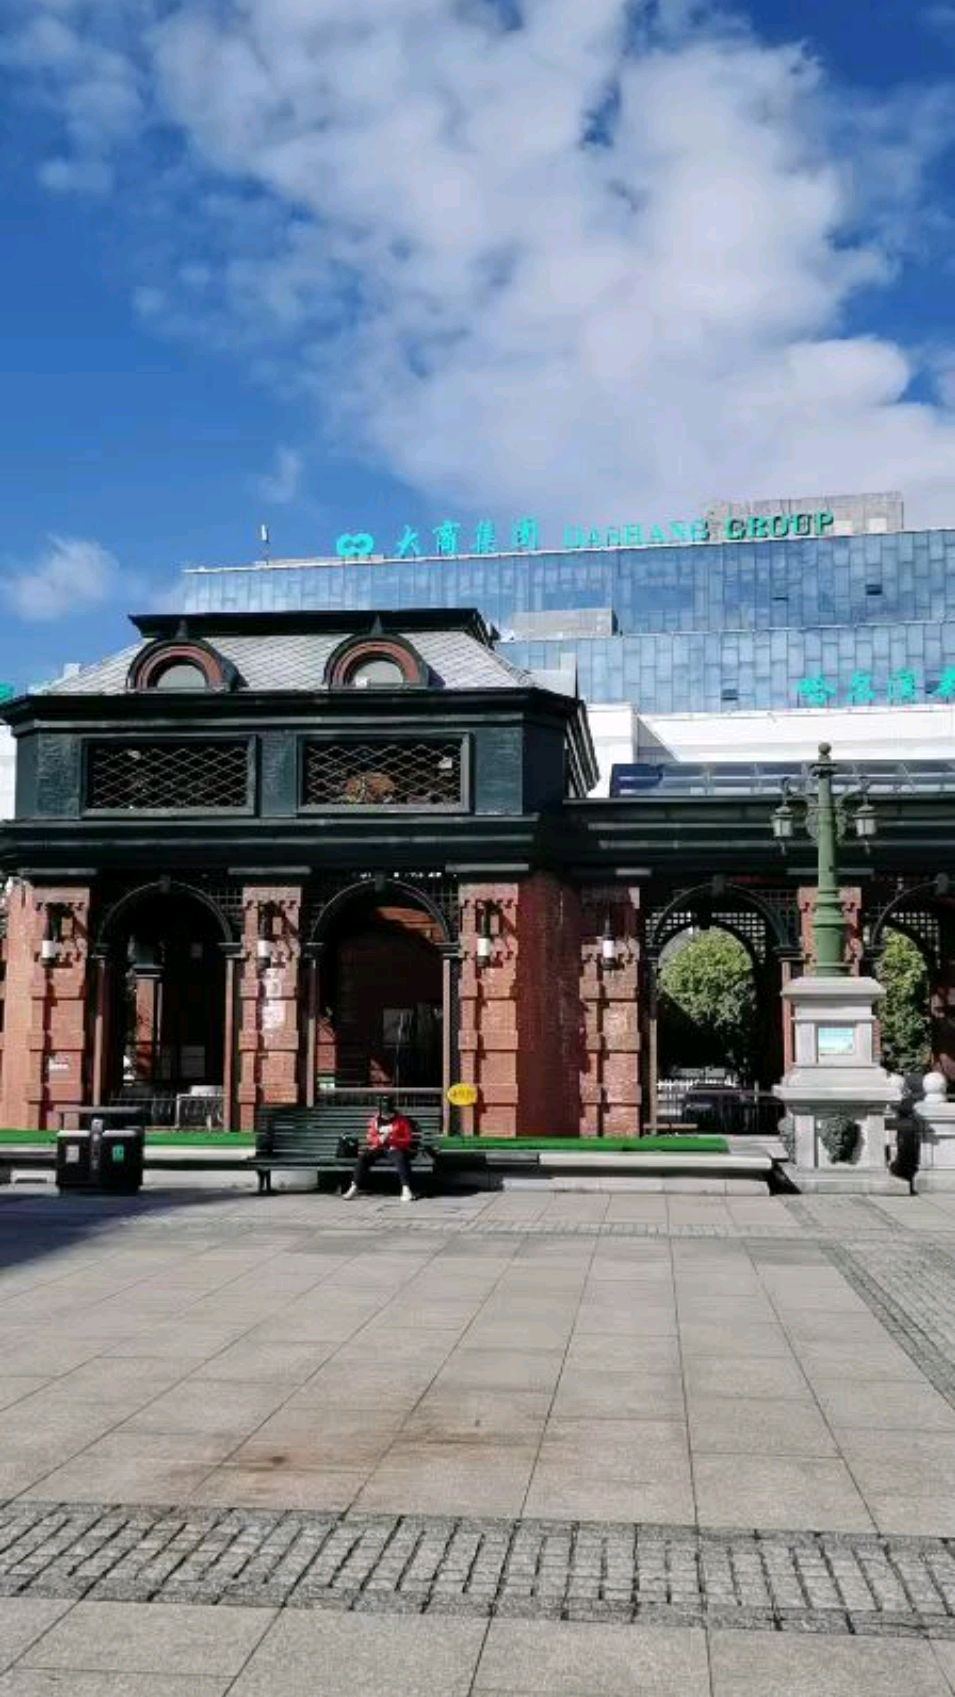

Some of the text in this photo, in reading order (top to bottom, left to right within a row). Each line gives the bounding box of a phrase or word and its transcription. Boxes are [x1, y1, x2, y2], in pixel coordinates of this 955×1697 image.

[396, 516, 540, 558] 大商集团
[725, 510, 834, 541] GROUP
